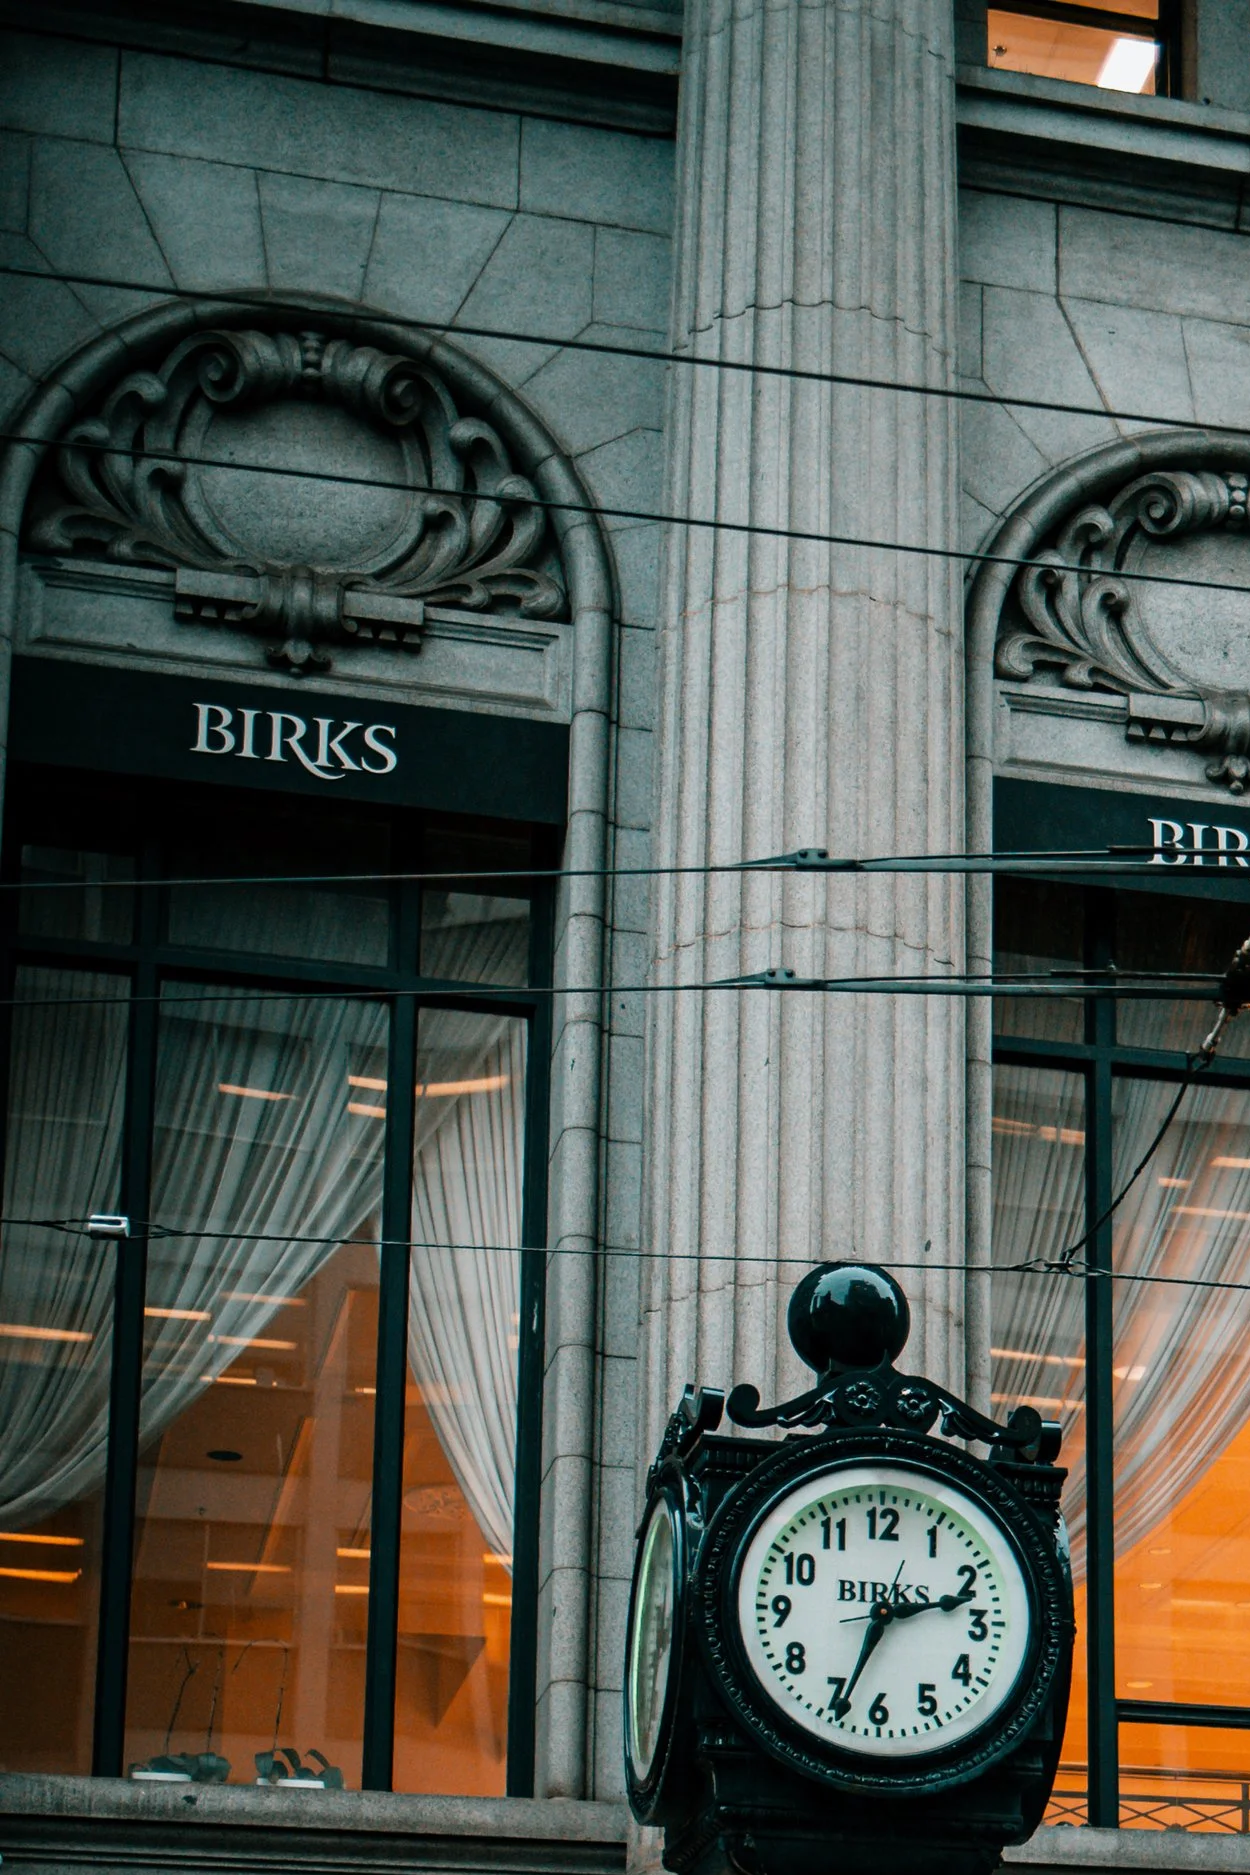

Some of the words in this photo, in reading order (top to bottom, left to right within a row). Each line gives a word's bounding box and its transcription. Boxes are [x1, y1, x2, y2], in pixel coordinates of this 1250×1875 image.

[189, 702, 398, 780] BIRKS
[821, 1517, 846, 1551] 11
[866, 1507, 899, 1541] 12
[927, 1525, 938, 1558] 1
[784, 1551, 815, 1586] 10
[956, 1565, 977, 1598] 2
[837, 1579, 930, 1605] BIRKS
[771, 1595, 792, 1628] 9
[968, 1609, 989, 1642] 3
[785, 1641, 806, 1675] 8
[951, 1654, 972, 1687] 4
[827, 1677, 847, 1711] 7
[868, 1693, 889, 1726] 6
[917, 1683, 937, 1717] 5
